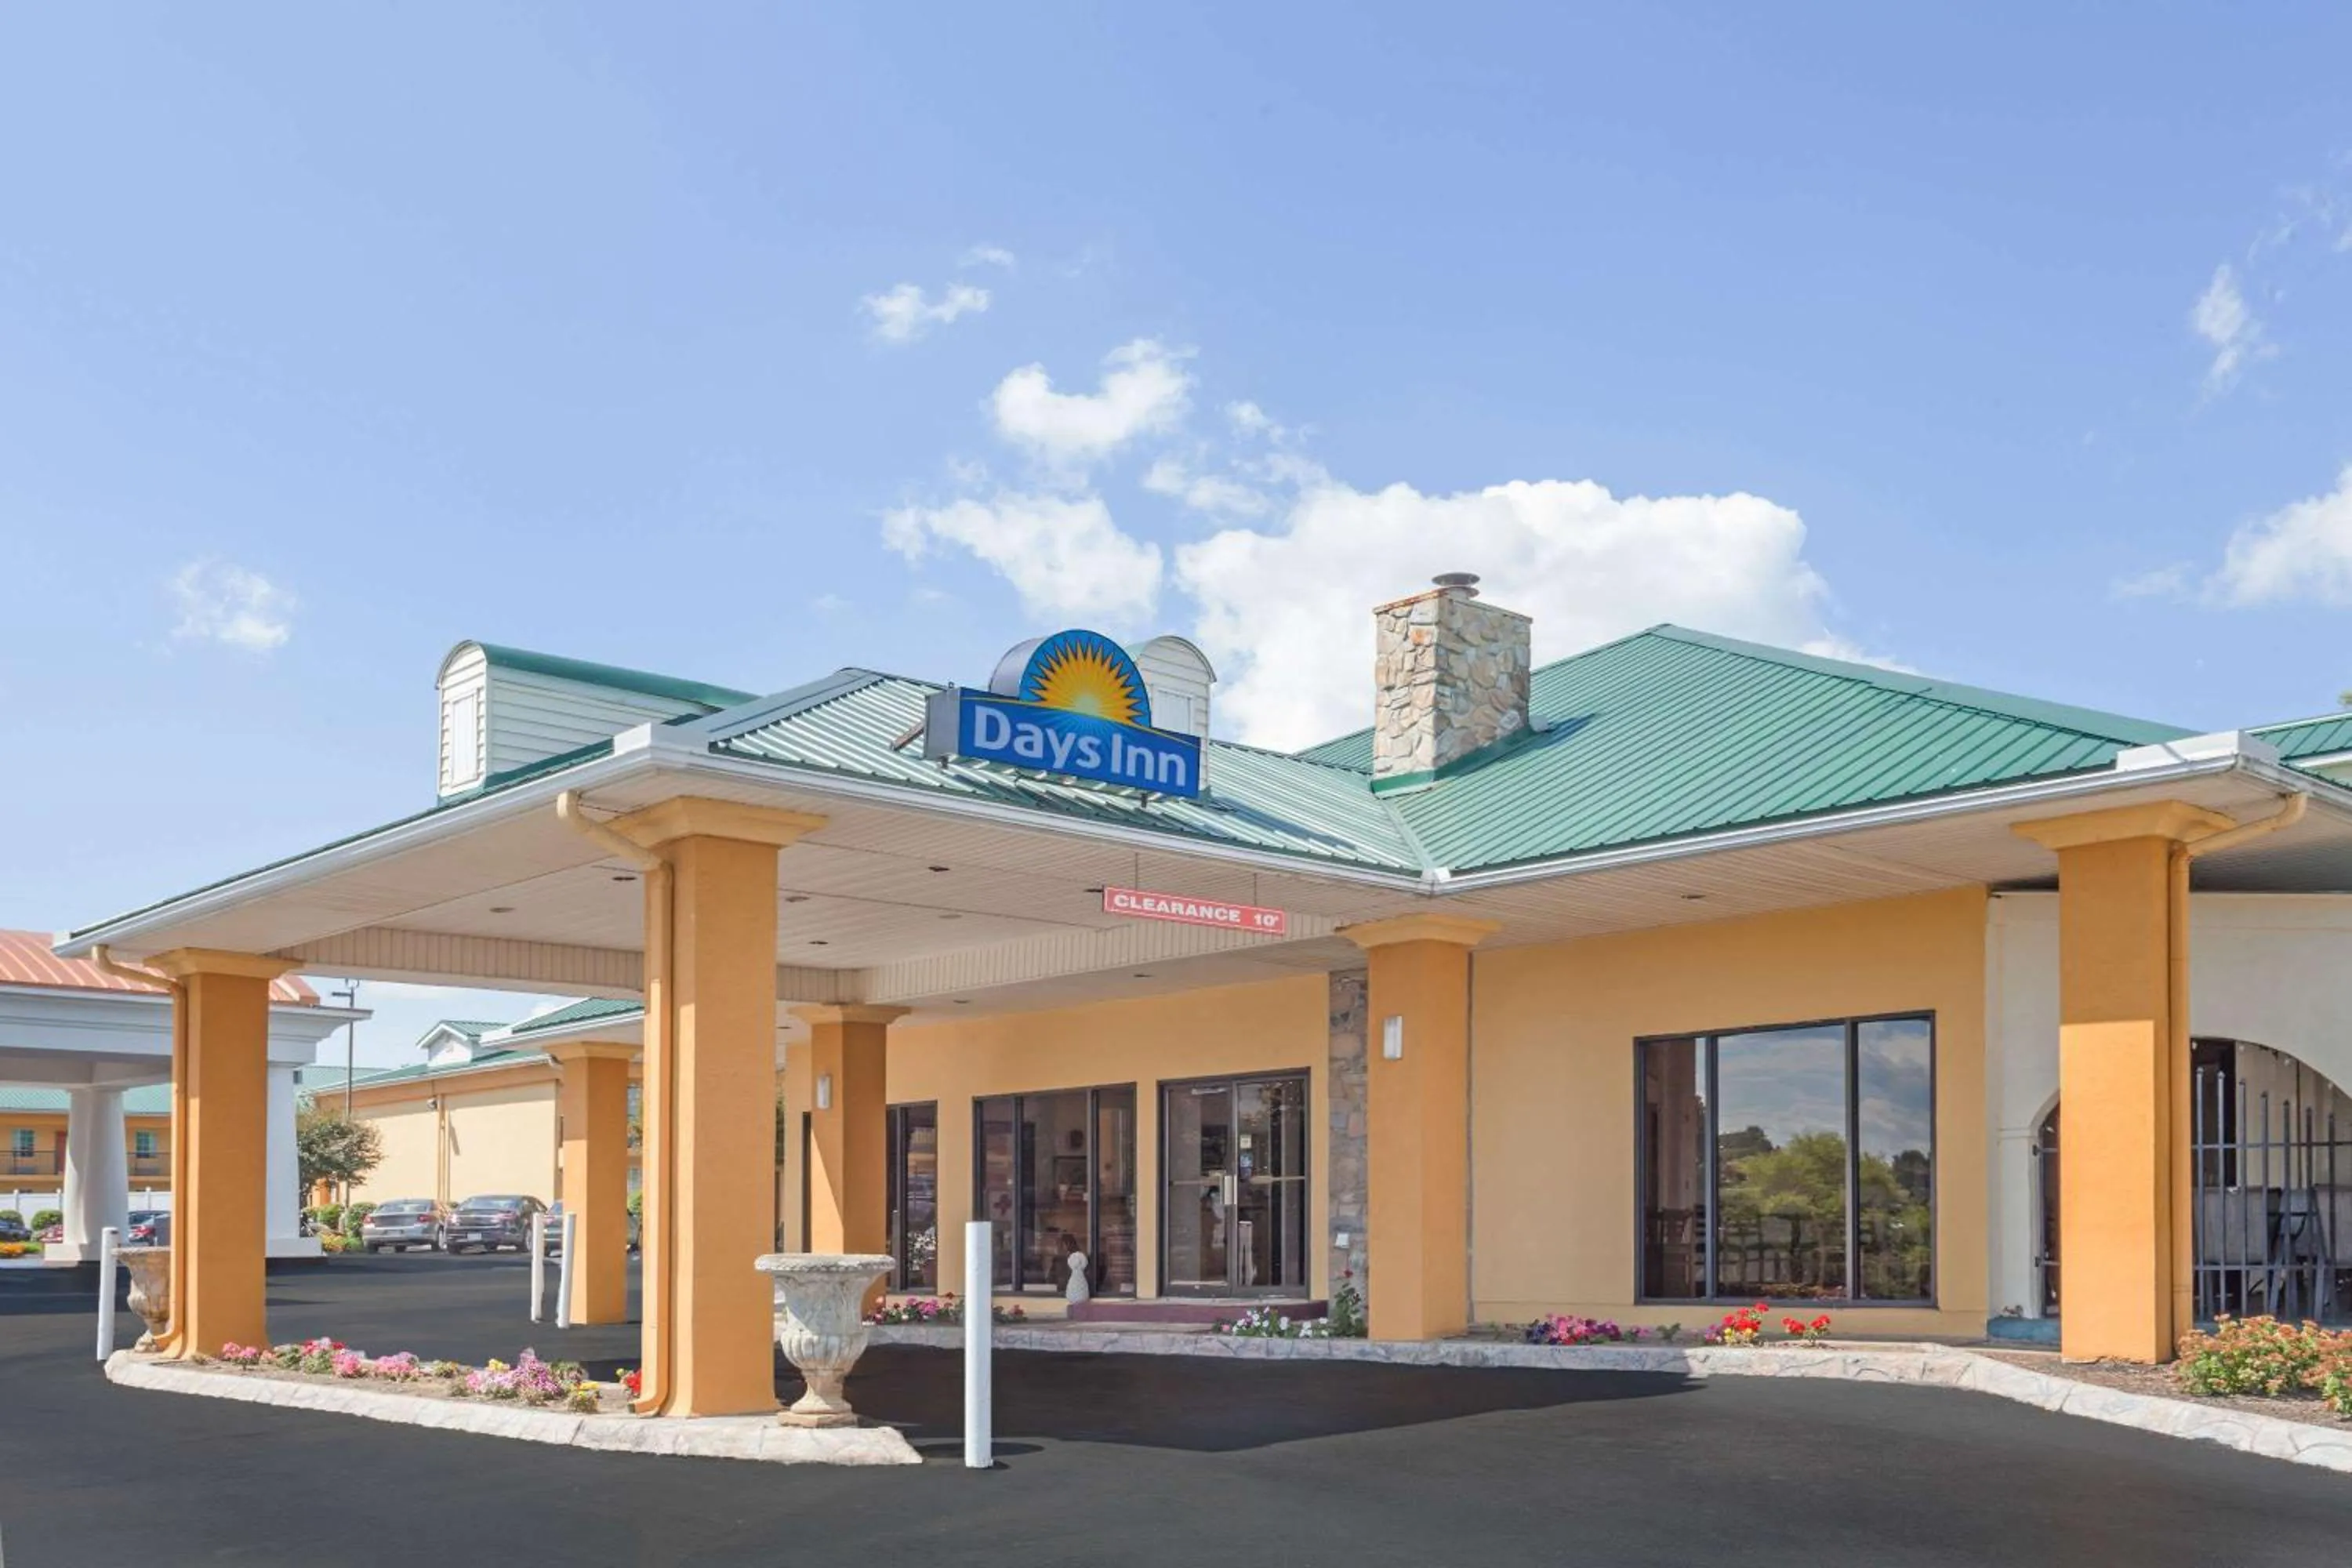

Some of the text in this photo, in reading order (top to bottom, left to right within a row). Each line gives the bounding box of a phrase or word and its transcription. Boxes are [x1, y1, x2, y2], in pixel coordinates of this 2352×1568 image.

[974, 705, 1186, 786] Days Inn
[1113, 893, 1241, 923] CLEARANCE
